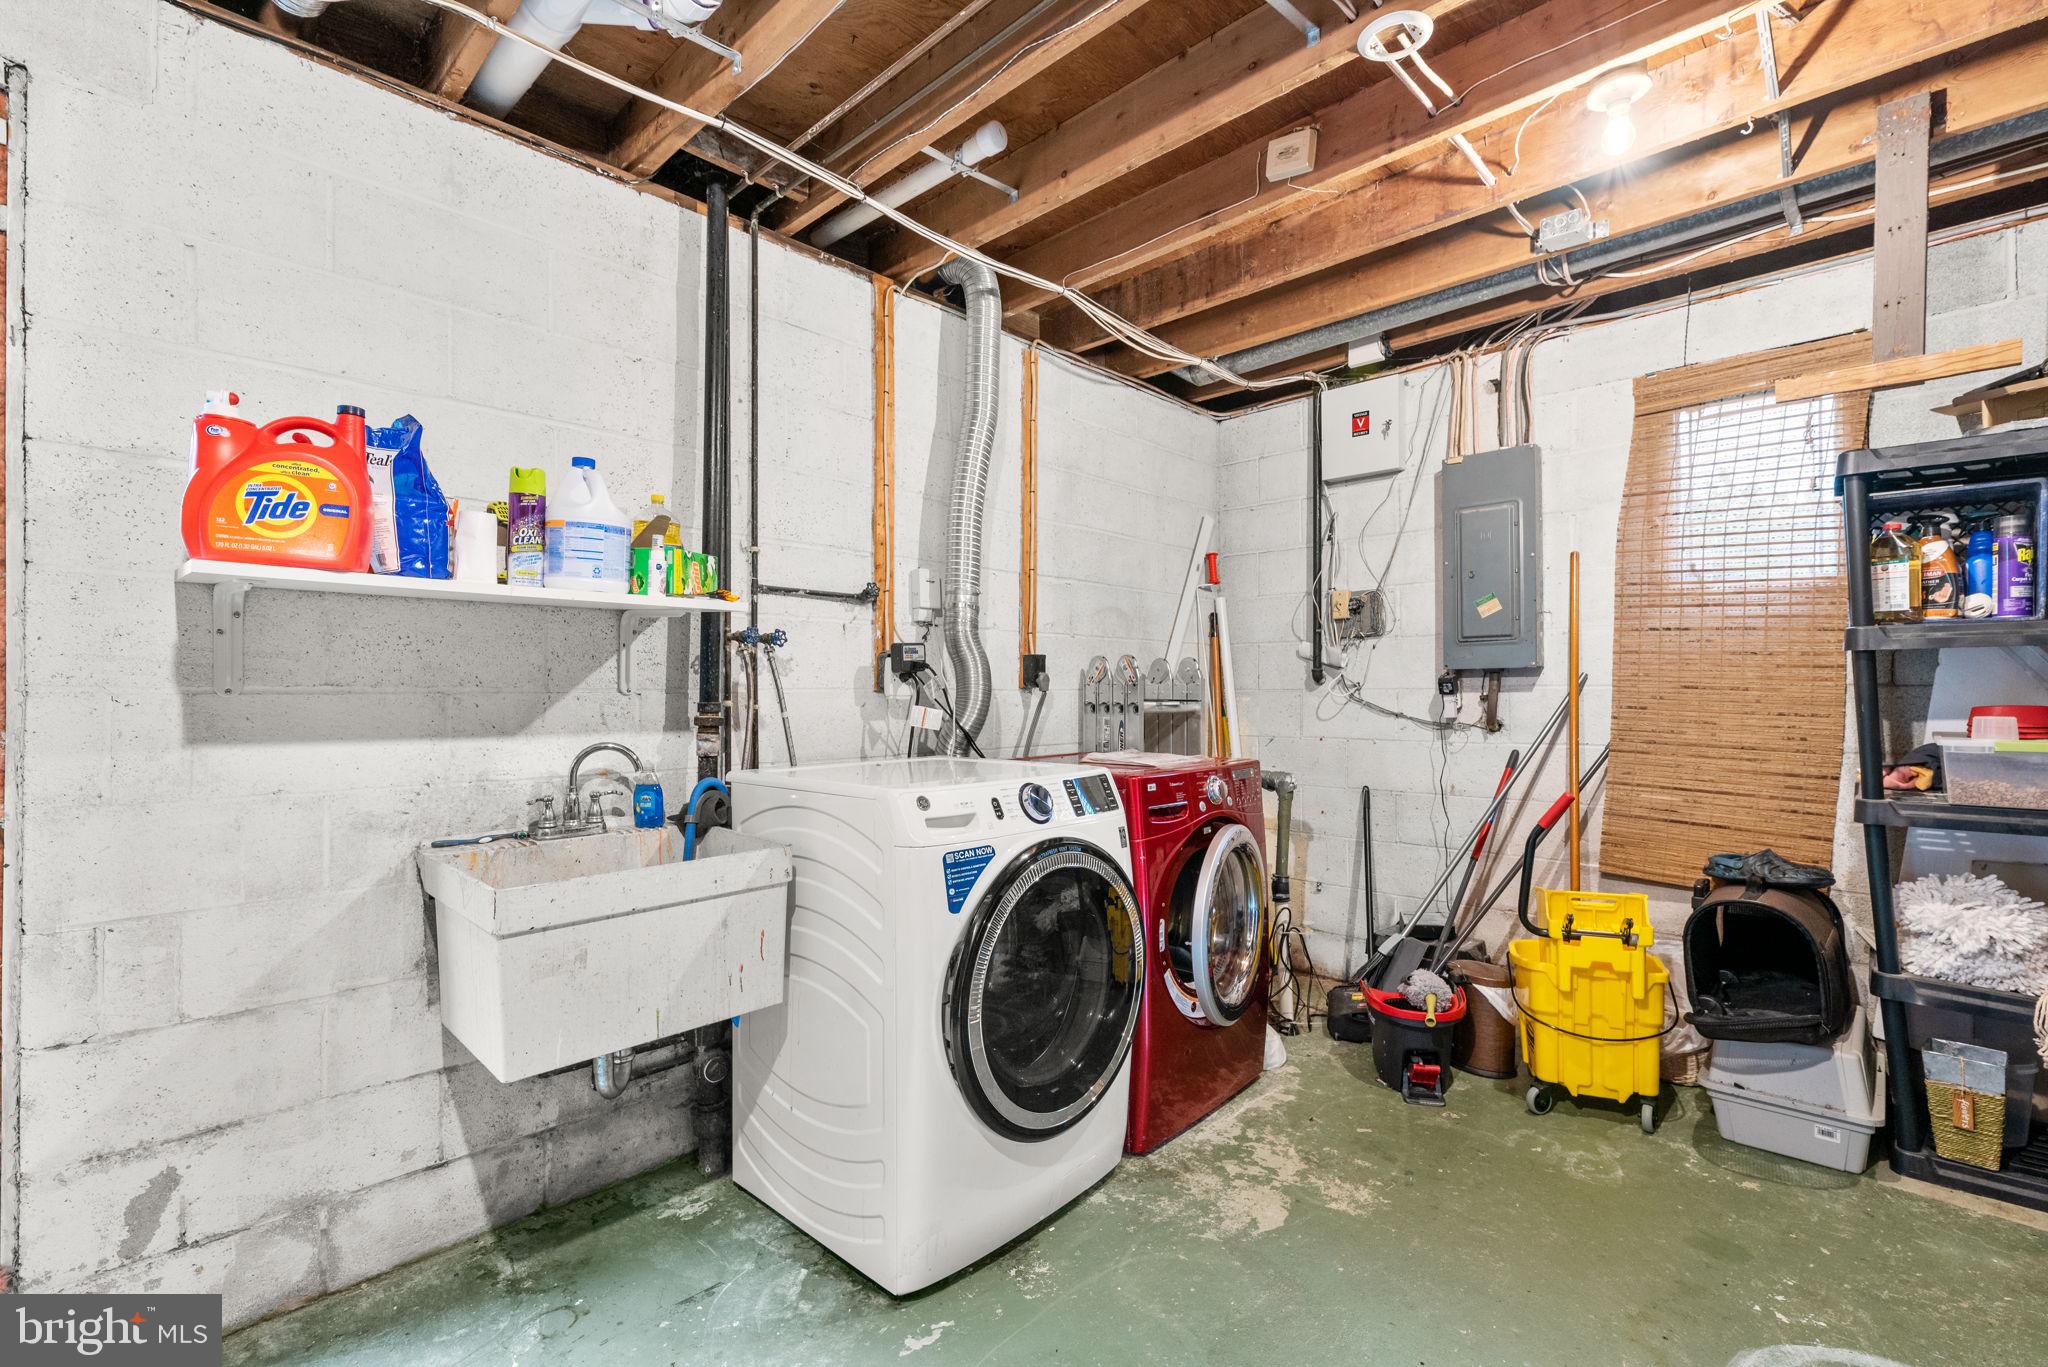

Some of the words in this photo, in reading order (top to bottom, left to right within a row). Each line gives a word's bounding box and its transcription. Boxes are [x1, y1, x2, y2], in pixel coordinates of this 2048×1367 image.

[1356, 416, 1365, 429] V
[243, 490, 311, 525] Tide
[519, 528, 538, 538] OXI
[513, 535, 541, 545] CLEAN
[954, 849, 975, 860] SCAN
[975, 846, 994, 857] NOW
